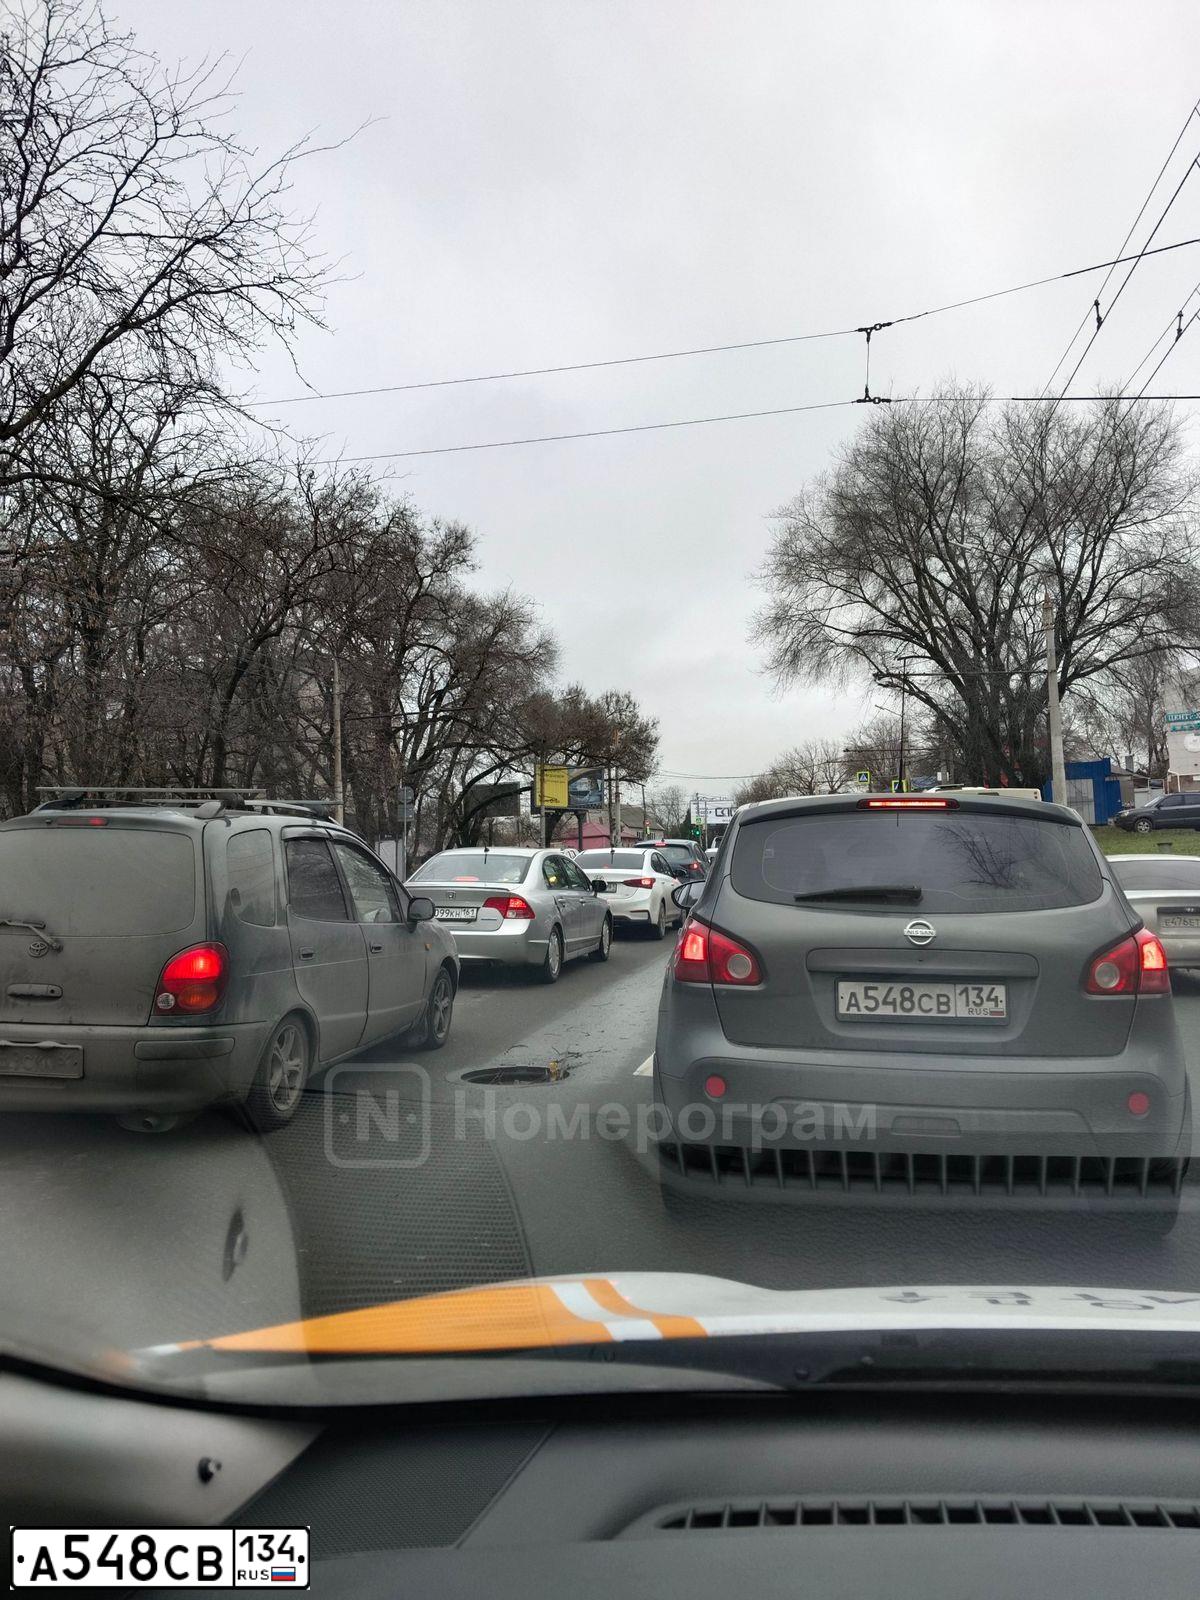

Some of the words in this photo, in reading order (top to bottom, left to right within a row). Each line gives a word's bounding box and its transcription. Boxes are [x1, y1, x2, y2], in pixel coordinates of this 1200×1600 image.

[846, 986, 951, 1014] А548СВ
[958, 986, 999, 1008] 134
[968, 1008, 989, 1016] RUS
